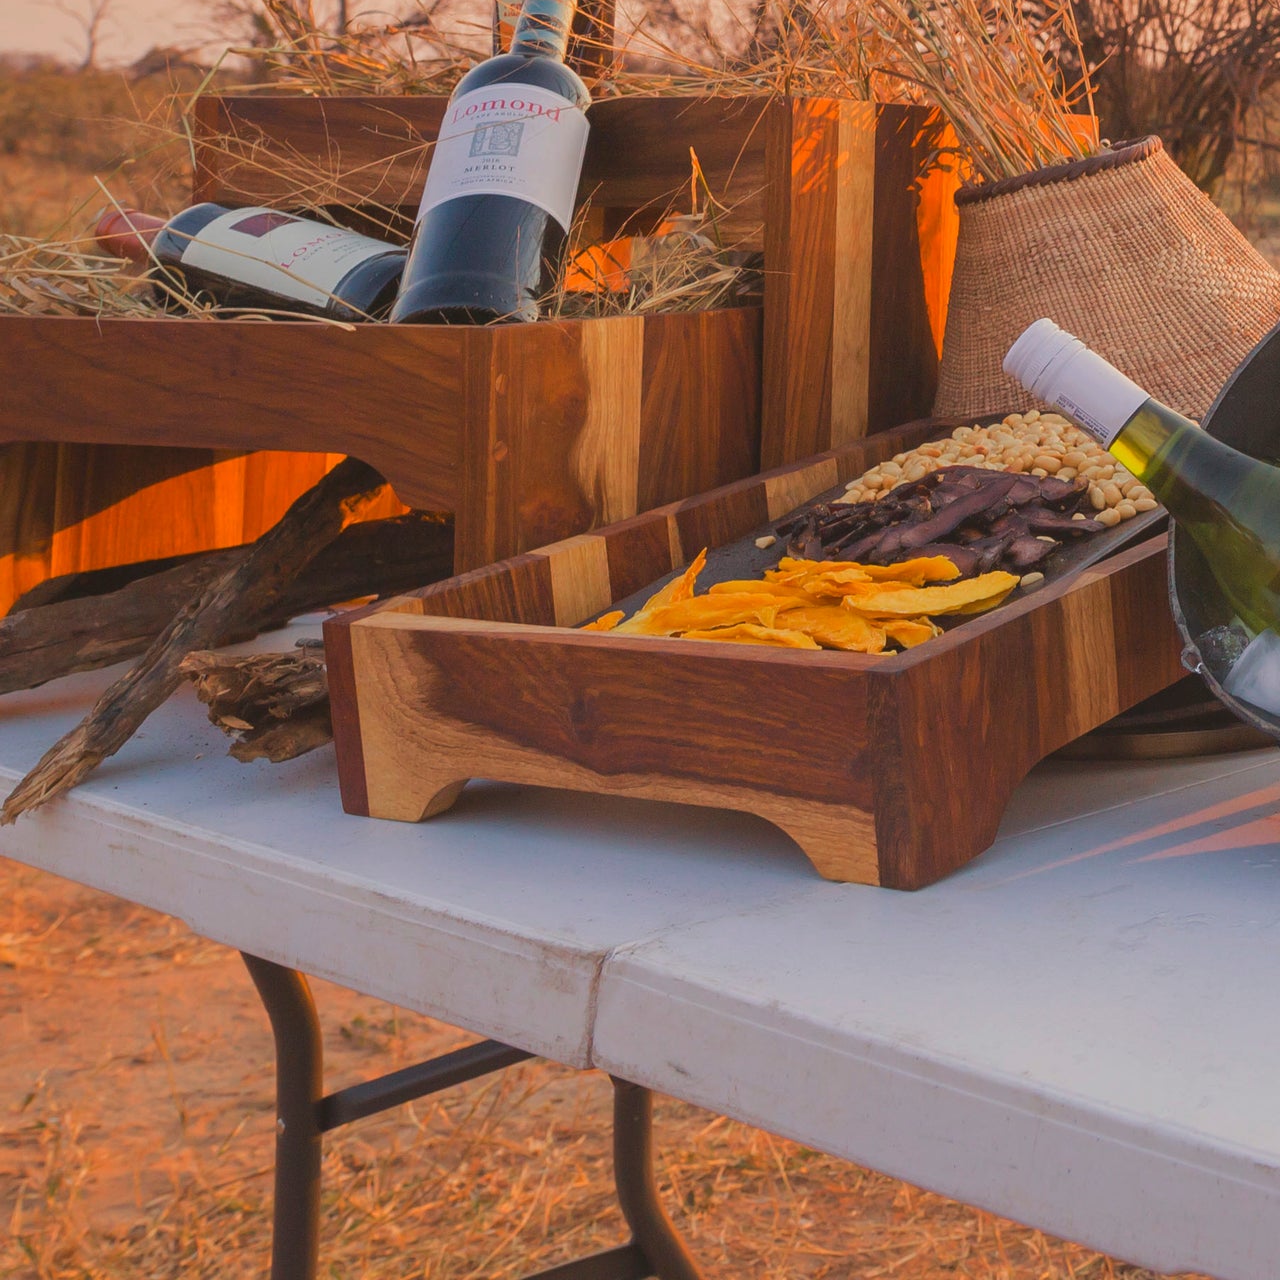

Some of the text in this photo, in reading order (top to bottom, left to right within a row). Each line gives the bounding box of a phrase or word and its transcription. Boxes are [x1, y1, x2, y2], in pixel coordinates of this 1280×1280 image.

[452, 99, 561, 124] Lomond
[464, 164, 516, 173] MERLOT
[281, 233, 343, 269] LOMO
